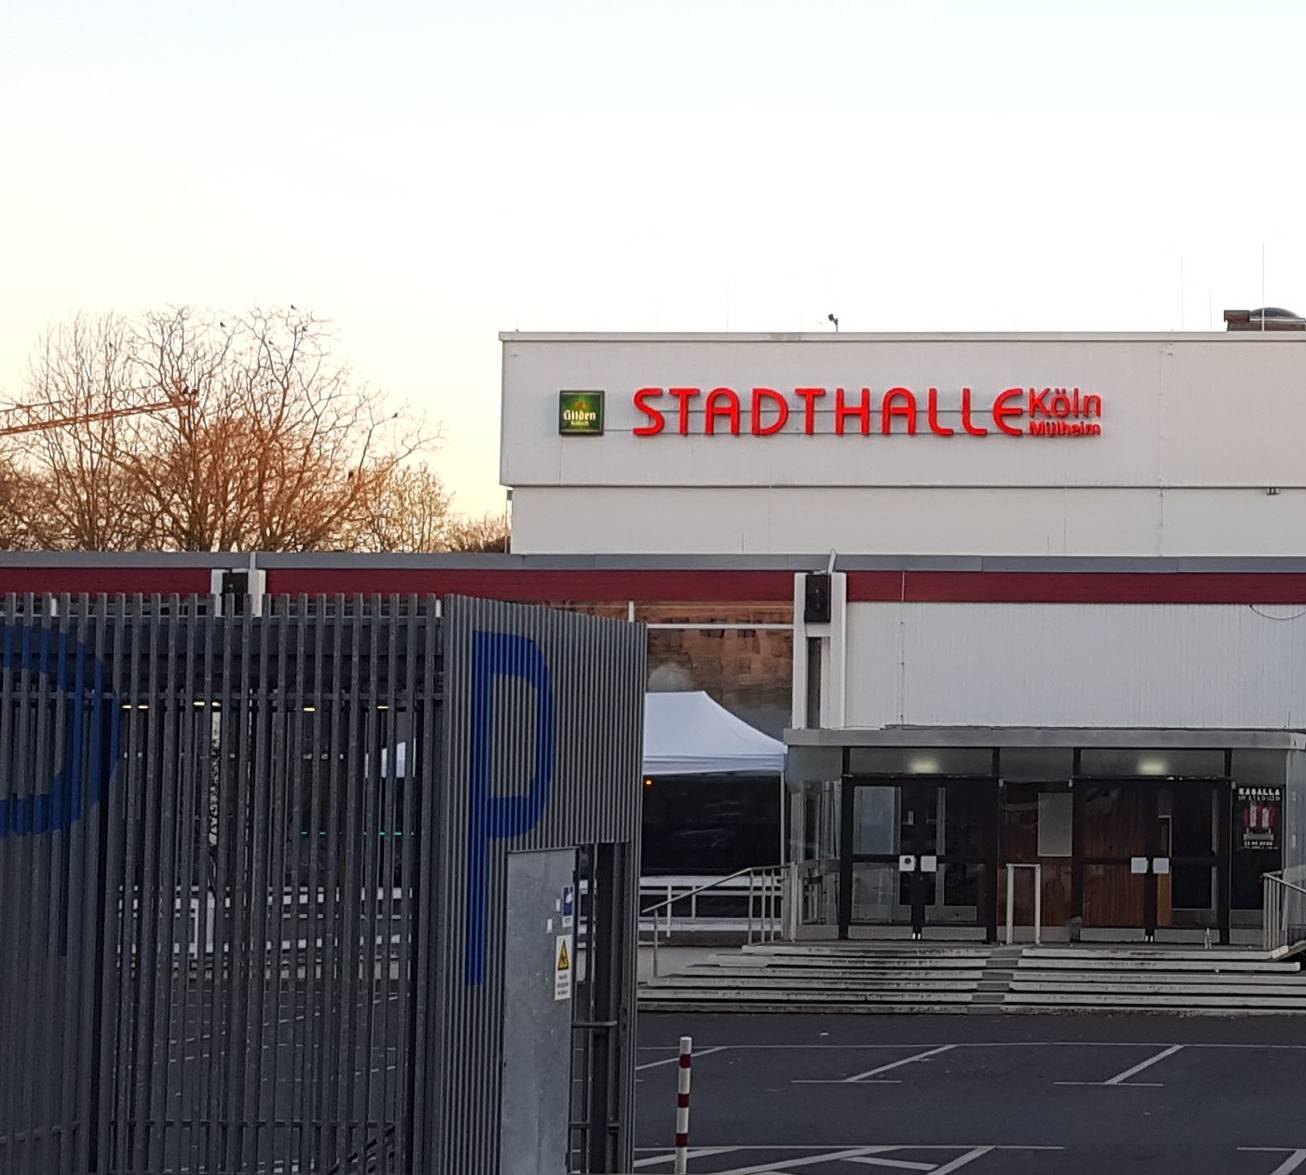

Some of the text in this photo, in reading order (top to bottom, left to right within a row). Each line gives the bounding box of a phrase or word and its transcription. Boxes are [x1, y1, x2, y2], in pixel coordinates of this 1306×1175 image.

[633, 387, 1102, 436] STADTHALLE Köln
[1029, 421, 1102, 437] Mülheim
